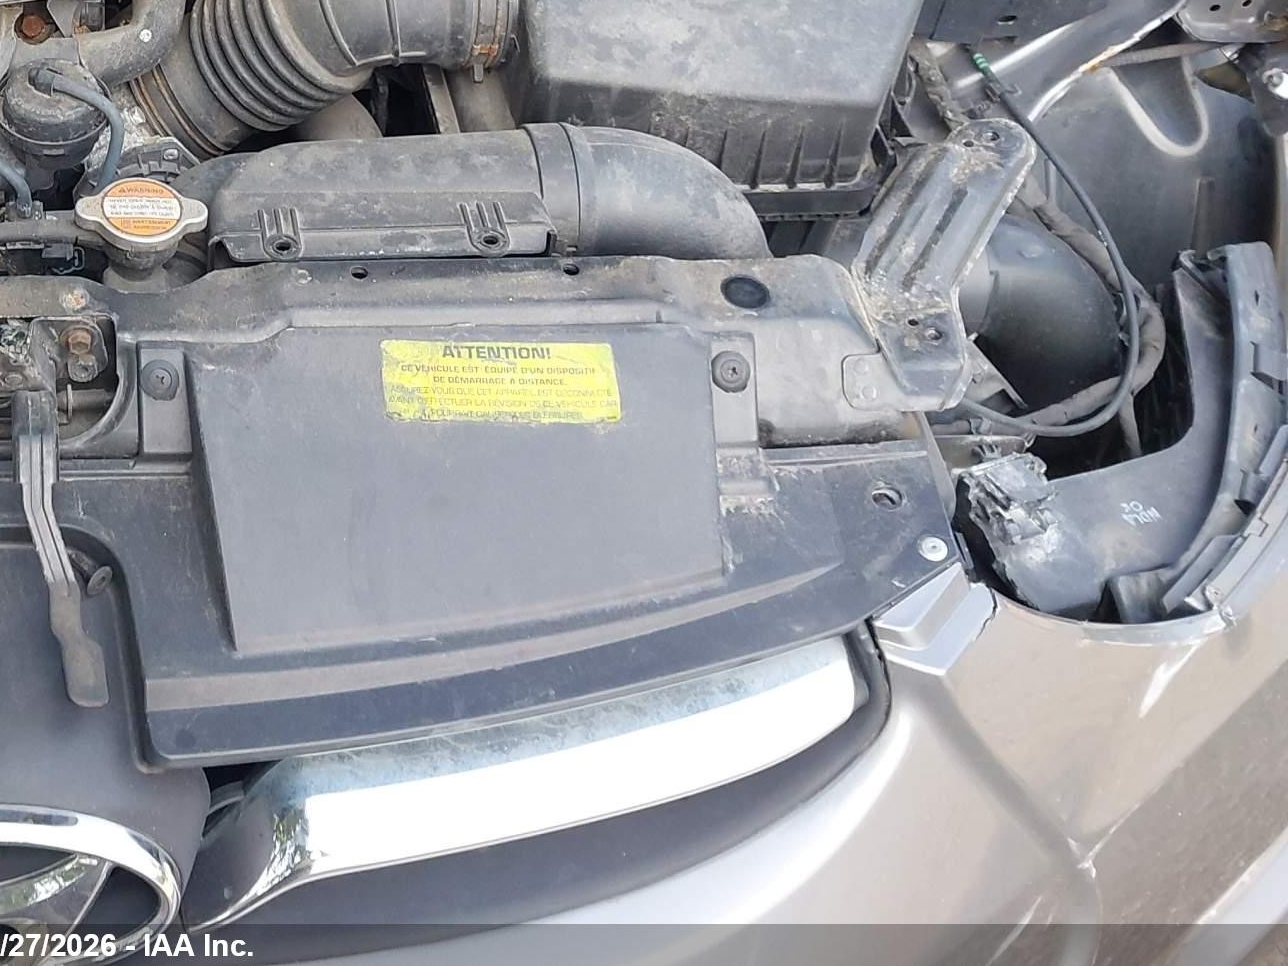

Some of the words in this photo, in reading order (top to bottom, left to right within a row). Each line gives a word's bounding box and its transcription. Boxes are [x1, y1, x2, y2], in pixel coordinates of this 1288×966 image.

[442, 345, 551, 360] ATTENTION!
[462, 365, 480, 374] EST
[433, 375, 446, 384] DE
